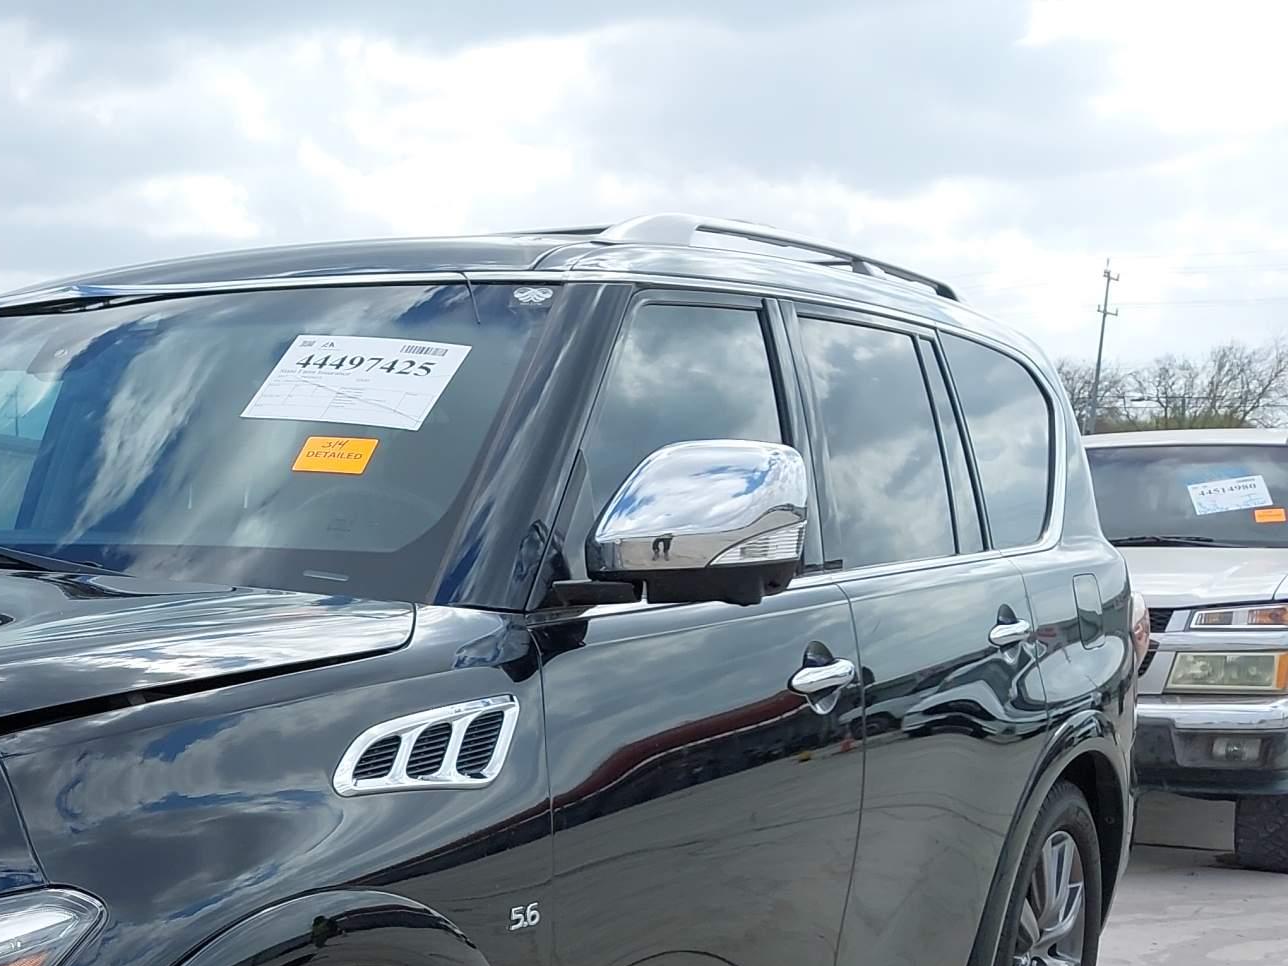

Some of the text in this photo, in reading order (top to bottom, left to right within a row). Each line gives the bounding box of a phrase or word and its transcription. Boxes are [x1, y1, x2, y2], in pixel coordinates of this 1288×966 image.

[296, 353, 437, 377] 44497425
[306, 450, 363, 460] DETAILED
[509, 902, 540, 931] 5.6
